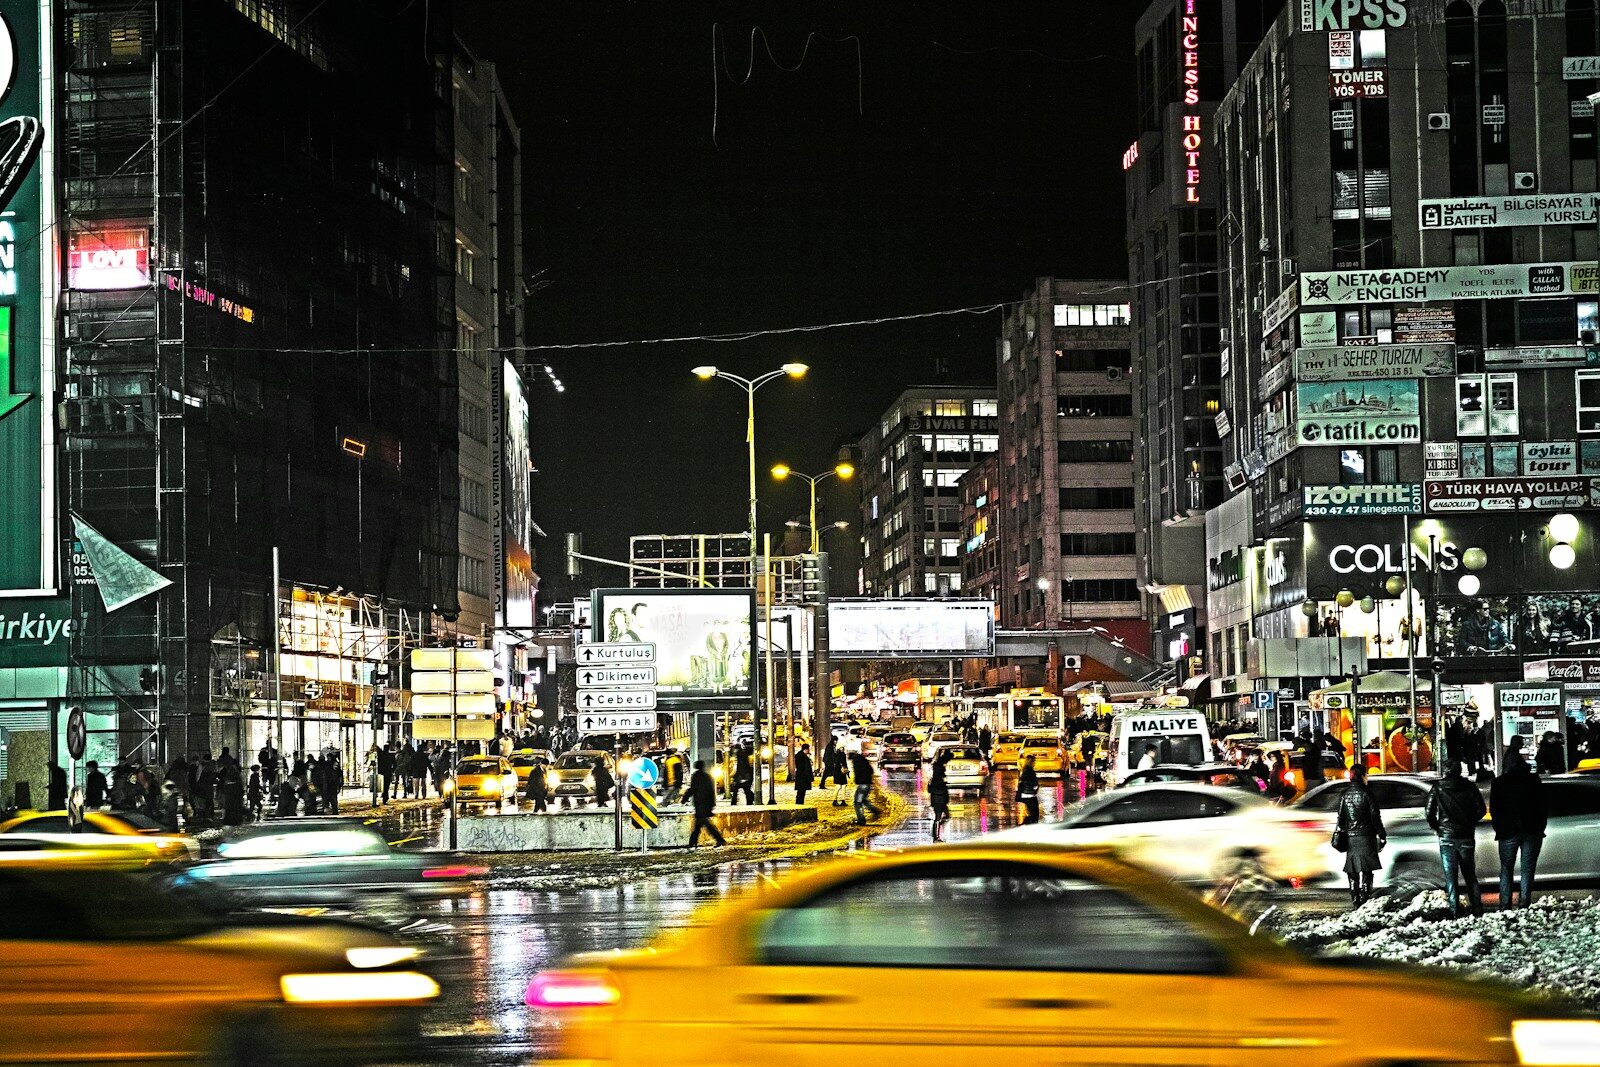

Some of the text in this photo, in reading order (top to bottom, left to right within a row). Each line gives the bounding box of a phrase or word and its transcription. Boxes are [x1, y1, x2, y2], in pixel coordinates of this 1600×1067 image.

[1303, 0, 1312, 30] RDEM
[1315, 0, 1407, 30] KPSS
[1565, 59, 1600, 71] ATA
[1333, 70, 1384, 84] TÖMER
[1334, 84, 1355, 97] YÖS
[1363, 85, 1384, 95] YDS
[1182, 115, 1201, 202] HOTEL
[1504, 196, 1583, 210] BİLGİSAYAR
[1444, 215, 1496, 226] BATIFEN
[1479, 268, 1495, 276] YDS
[1538, 267, 1554, 275] with
[1337, 269, 1450, 286] NETACADEMY
[1460, 278, 1515, 287] TOEFL IELTS
[1532, 275, 1560, 284] CALLAN
[1357, 286, 1427, 301] ENGLISH
[1451, 288, 1524, 298] HAZIRLIK ATLAMA
[1533, 285, 1560, 293] Method
[1344, 338, 1376, 346] KAT.4
[1343, 347, 1422, 367] SEHER TURİZM
[1304, 361, 1324, 369] THY
[1324, 421, 1419, 440] tatil.com
[1528, 444, 1571, 458] öykü
[1428, 460, 1457, 469] KIBRIS
[1529, 461, 1571, 472] tour
[1446, 482, 1482, 495] TÜRK
[1485, 483, 1524, 495] HAVA
[1305, 506, 1327, 515] 430
[1329, 506, 1343, 515] 47
[1346, 505, 1359, 514] 47
[597, 648, 651, 658] Kurtuluş
[597, 671, 650, 681] Dikimevi
[597, 695, 647, 703] Cebeci
[1258, 692, 1270, 708] P
[1501, 692, 1558, 705] taspınar
[598, 717, 650, 726] Mamak
